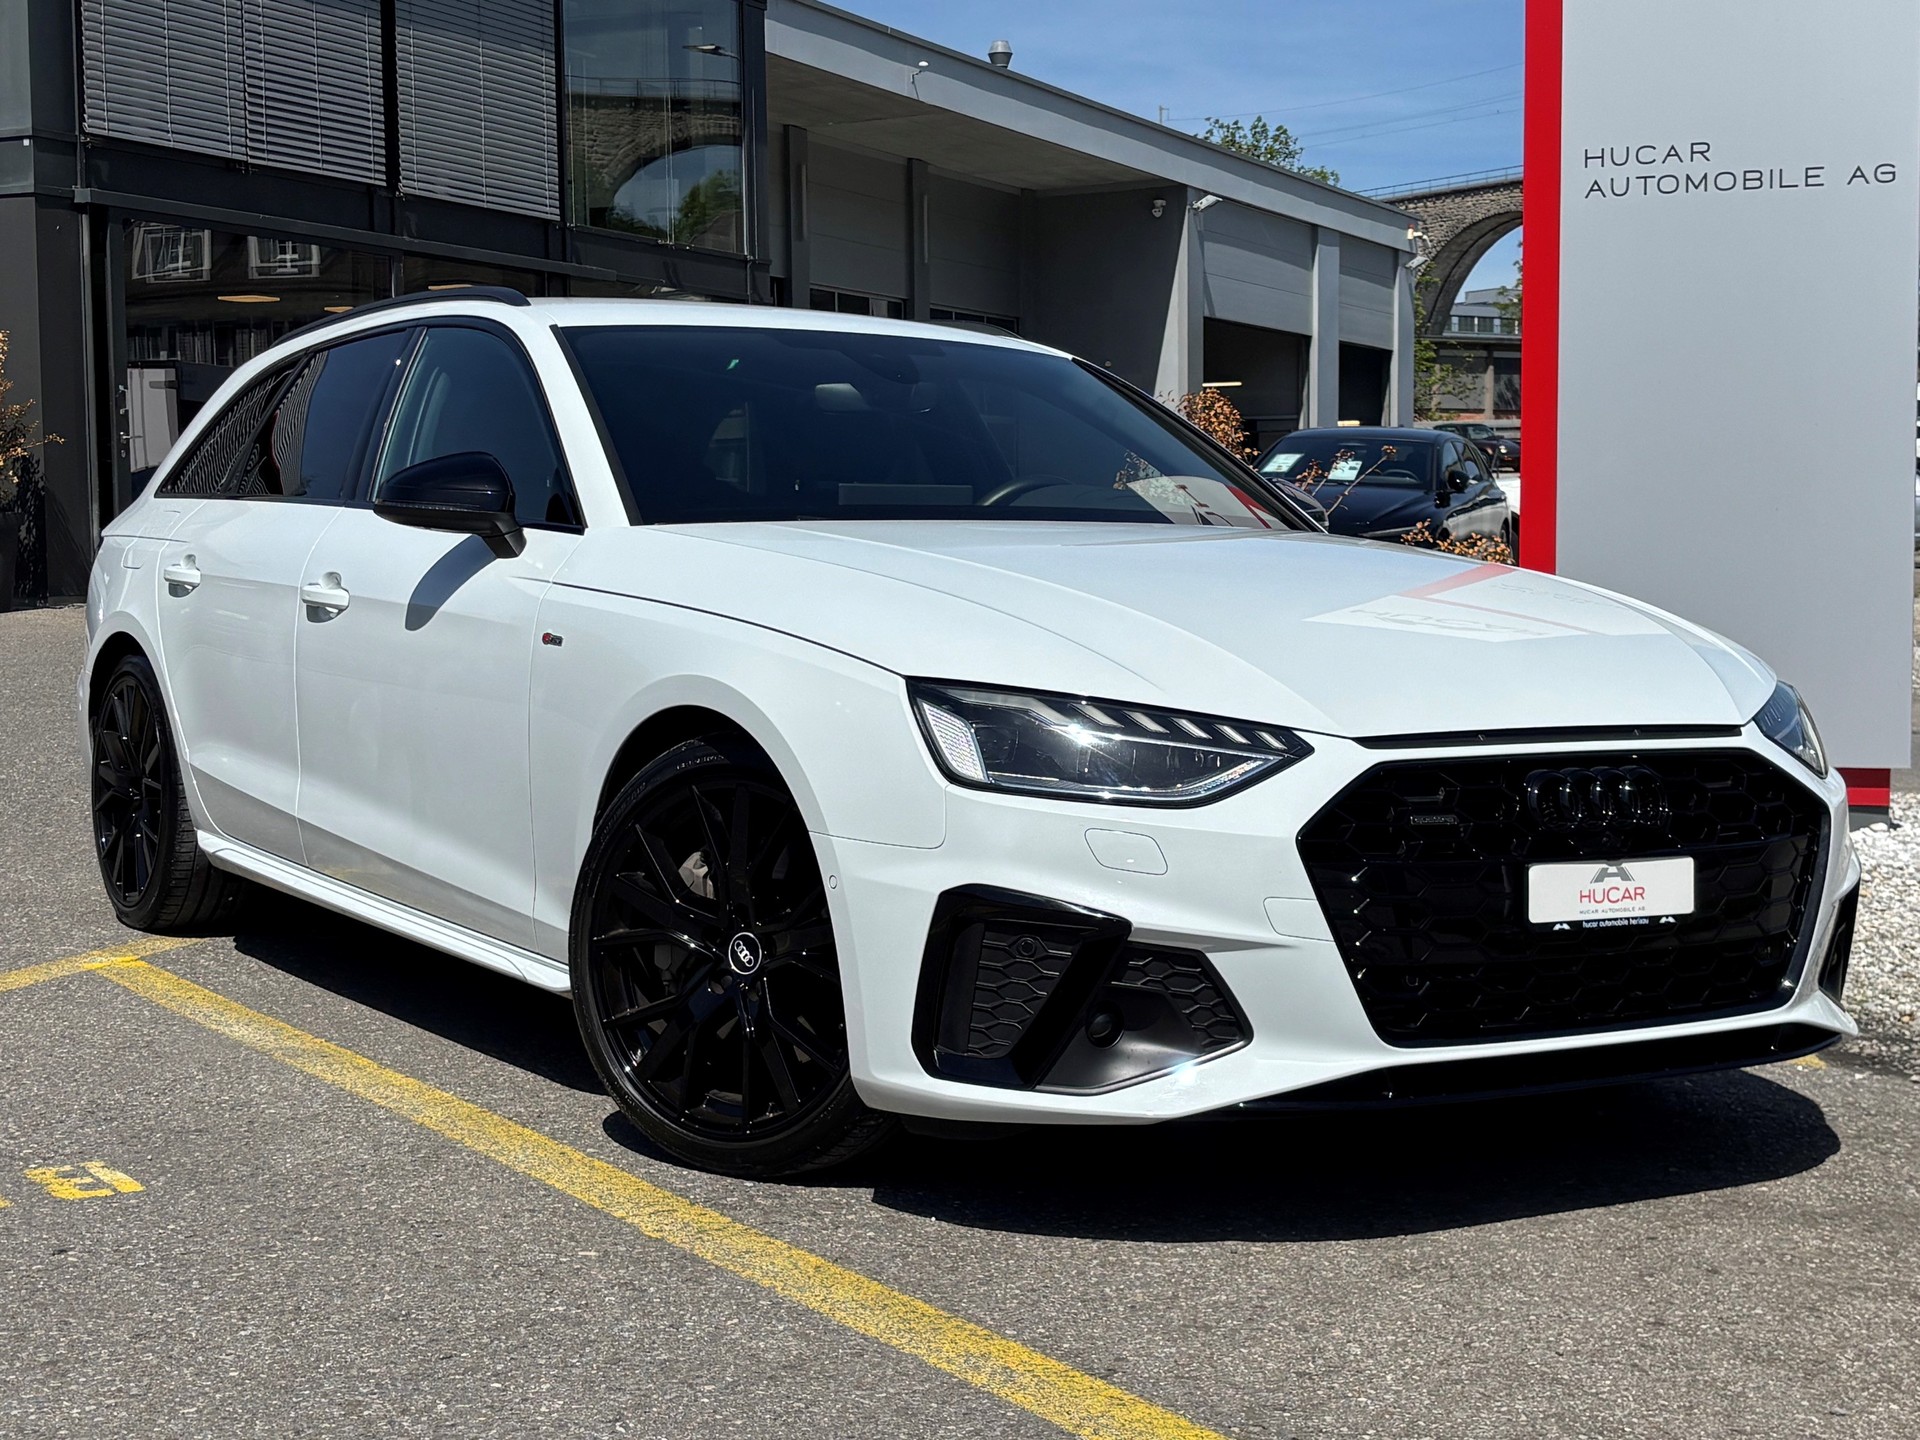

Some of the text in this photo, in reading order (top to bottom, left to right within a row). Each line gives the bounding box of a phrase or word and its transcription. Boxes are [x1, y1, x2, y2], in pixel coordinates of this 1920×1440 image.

[1584, 142, 1711, 168] HUCAR
[1584, 163, 1897, 199] AUTOMOBILE AG
[1579, 886, 1645, 904] HUCAR
[1601, 906, 1636, 914] AUTOMOBILE
[1582, 920, 1598, 928] hucar
[1599, 918, 1629, 927] automobile
